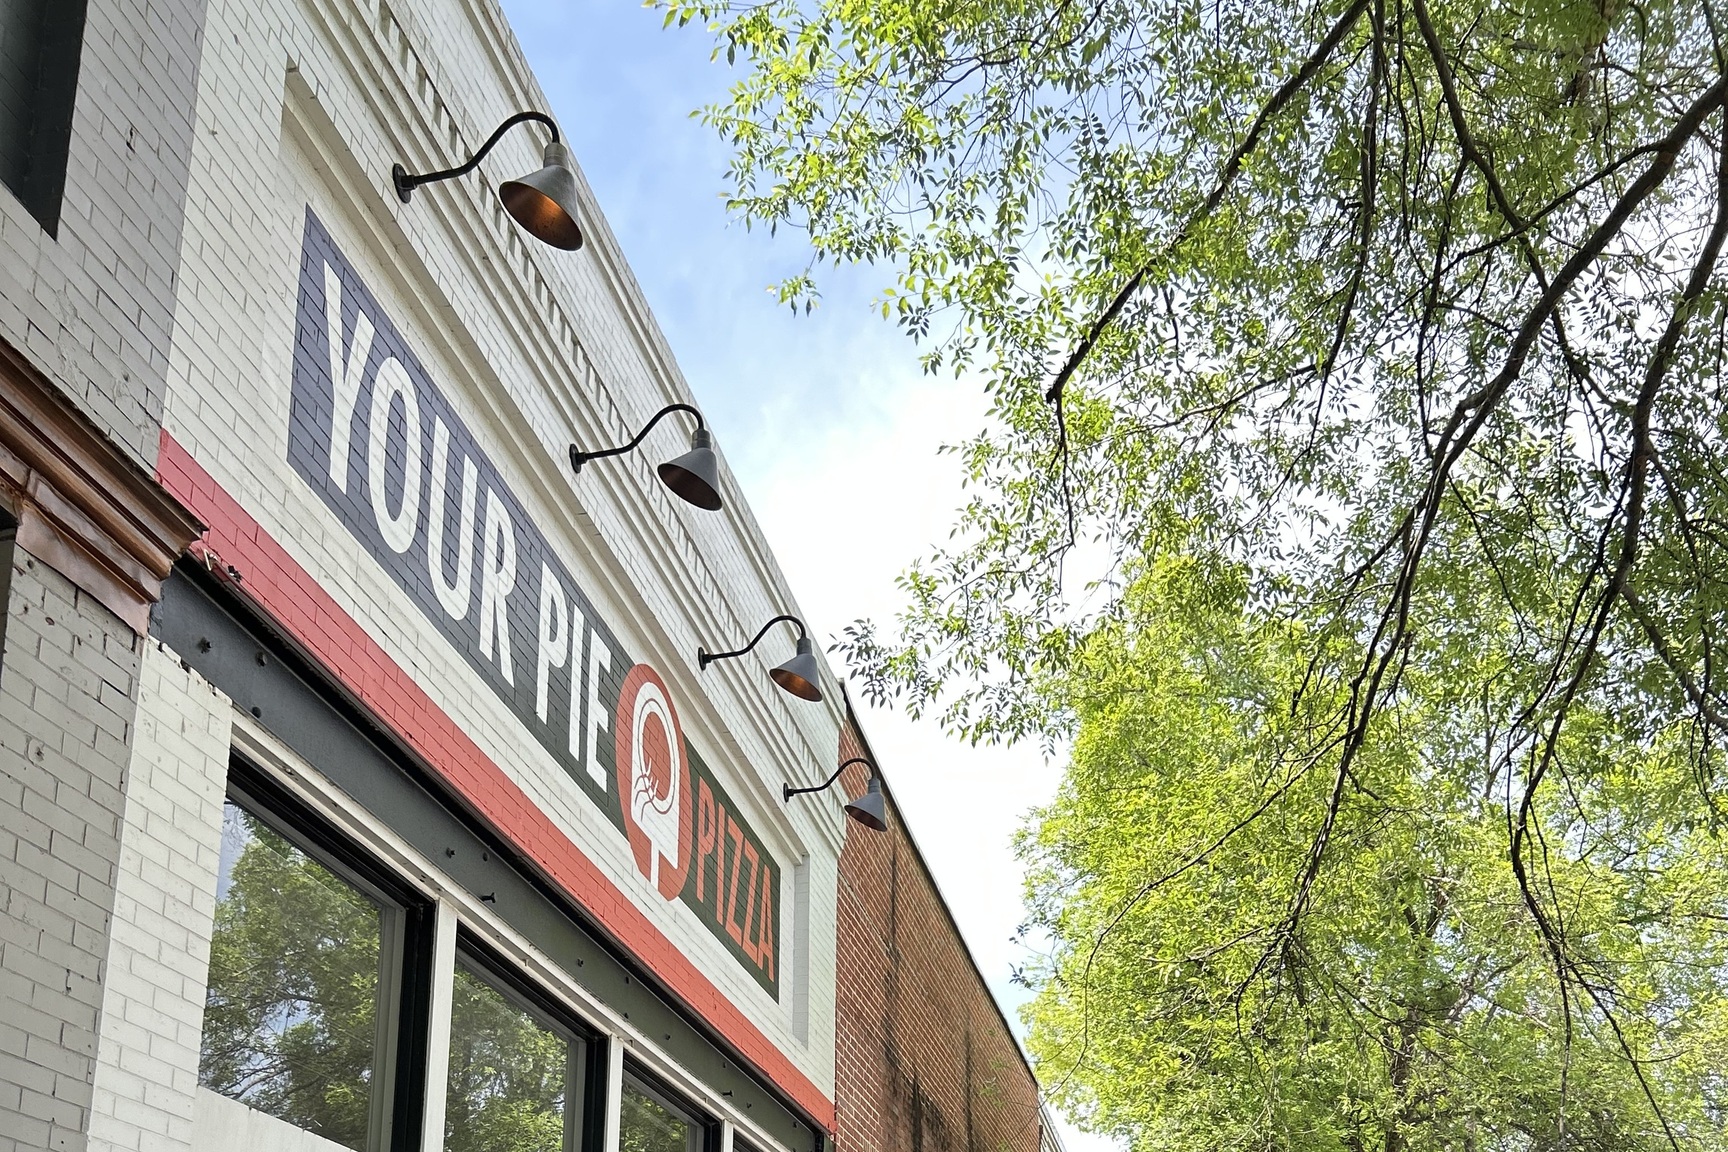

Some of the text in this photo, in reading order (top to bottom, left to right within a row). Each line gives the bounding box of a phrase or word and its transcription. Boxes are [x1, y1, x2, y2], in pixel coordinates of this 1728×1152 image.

[323, 260, 776, 977] YOUR PIE PIZZA
